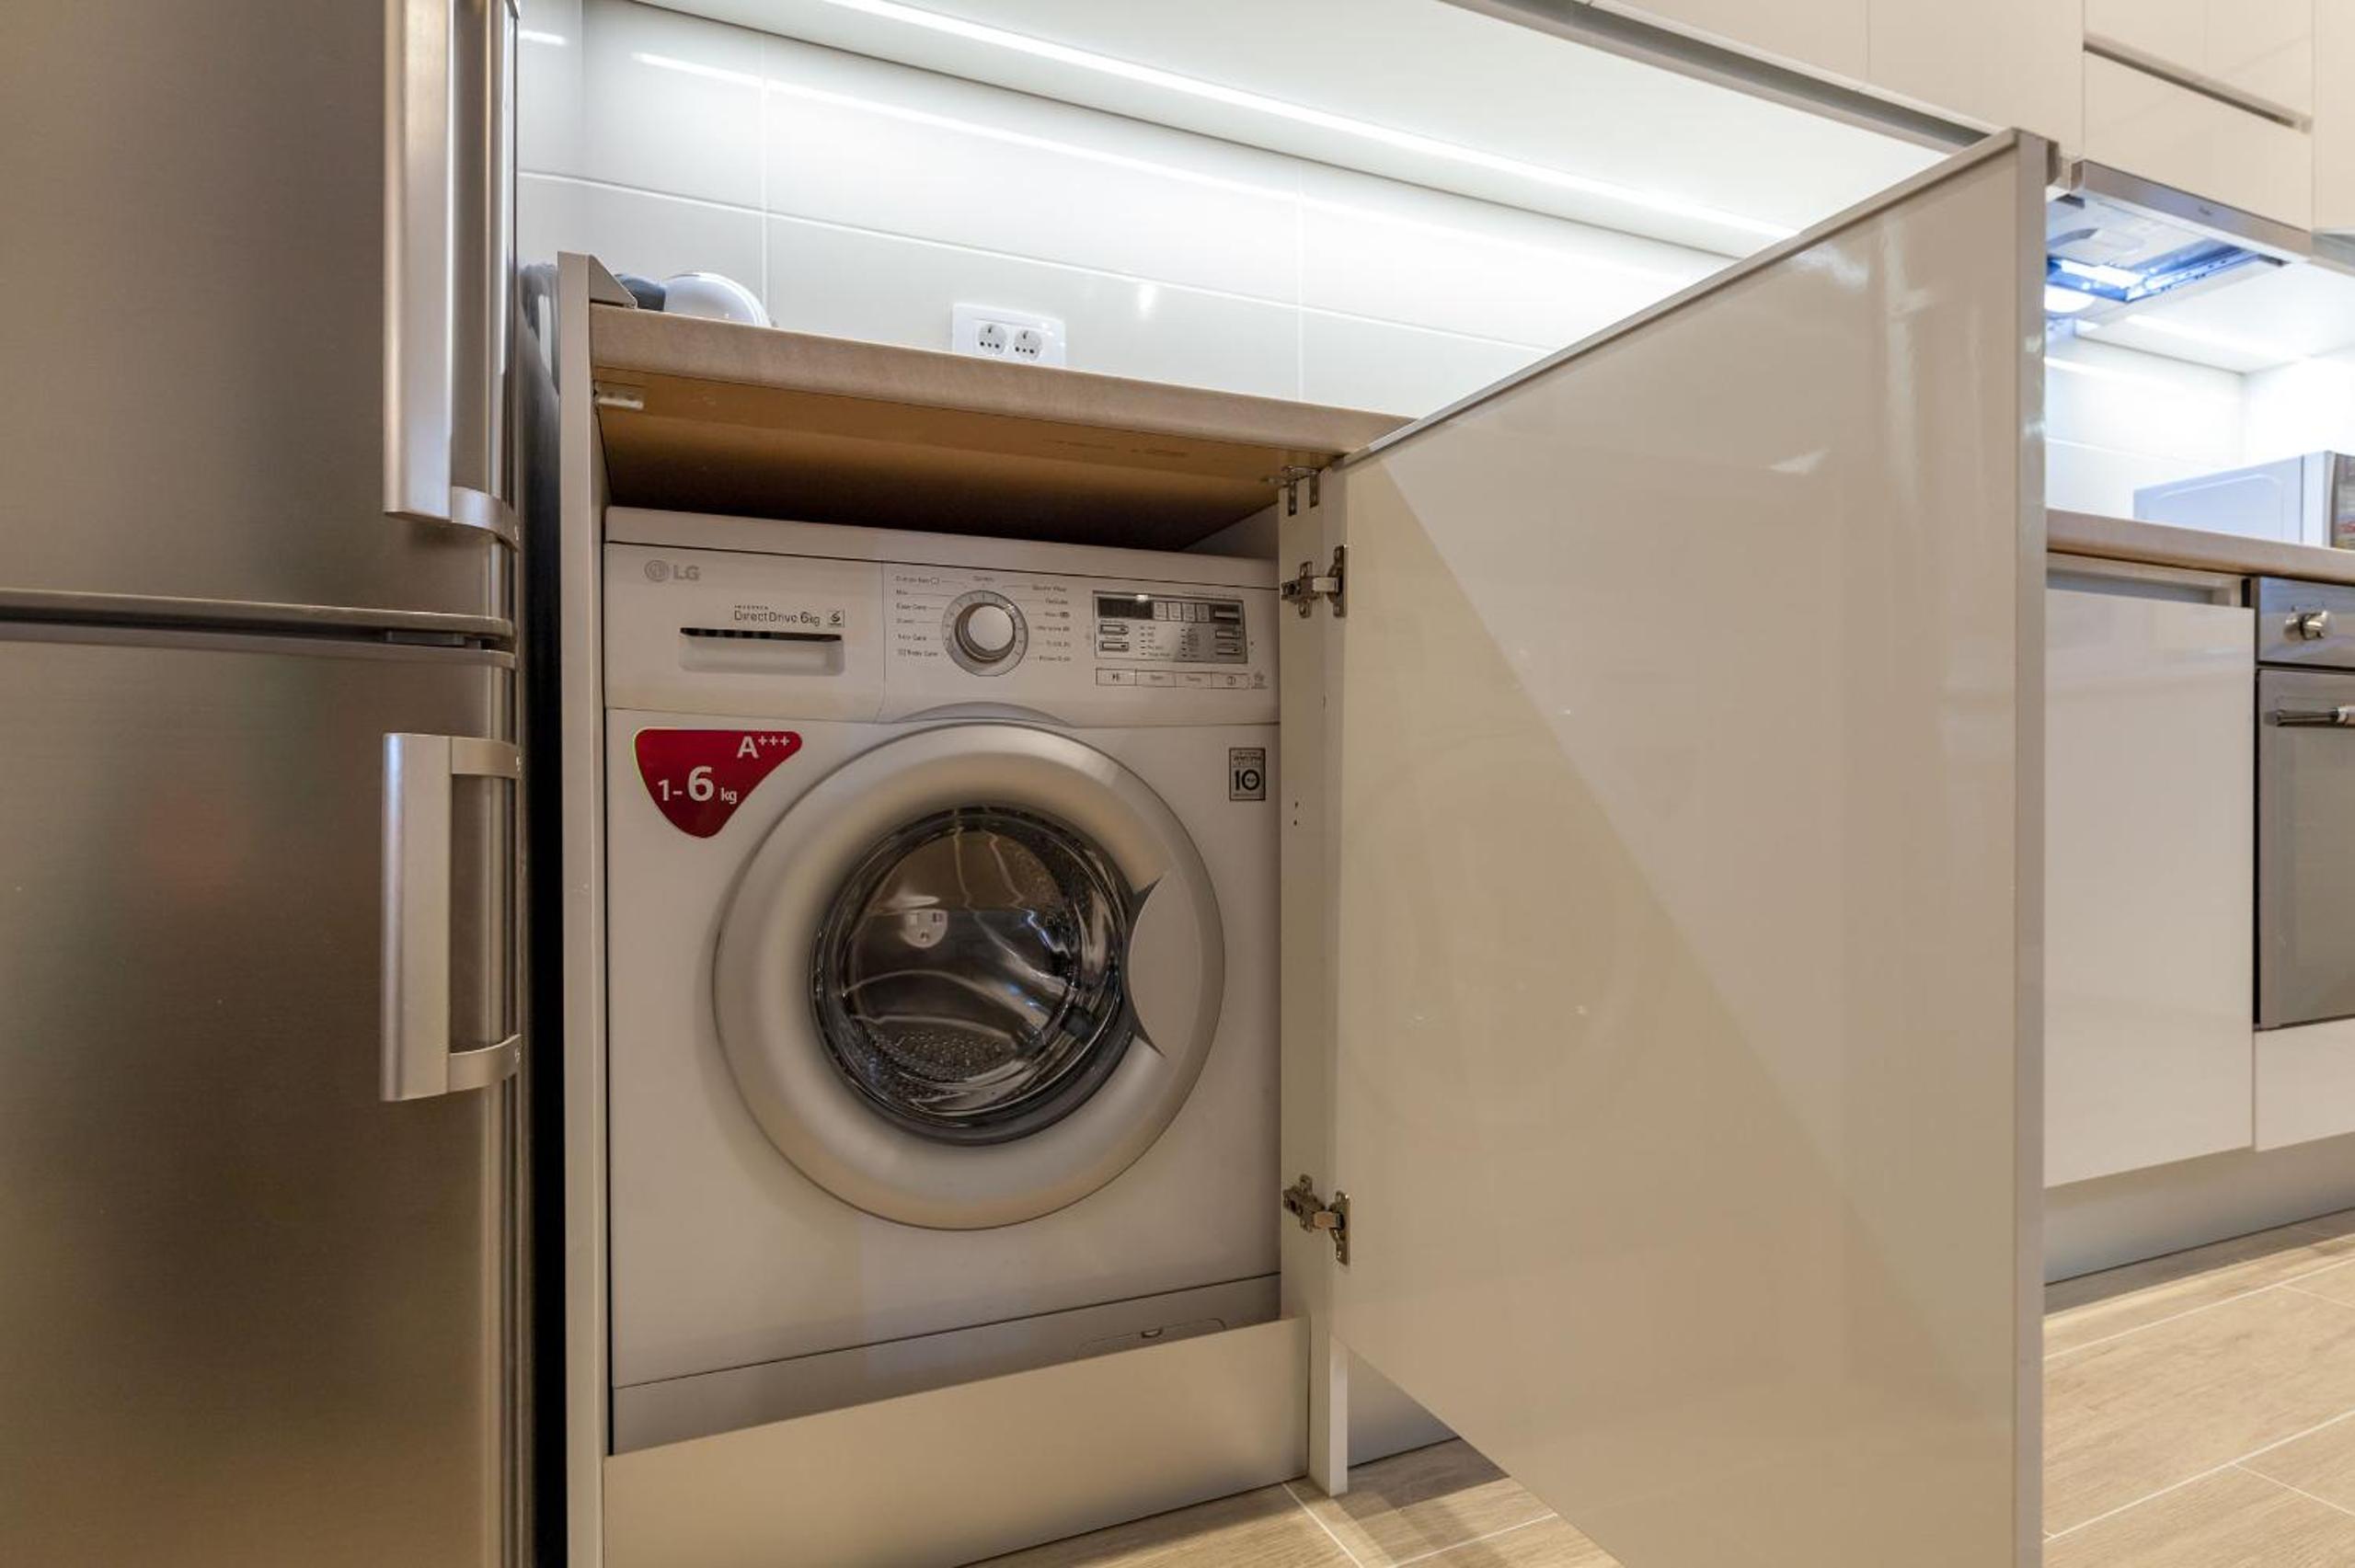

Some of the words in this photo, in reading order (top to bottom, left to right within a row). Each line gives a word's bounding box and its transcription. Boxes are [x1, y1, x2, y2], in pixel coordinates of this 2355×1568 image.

[673, 565, 700, 580] LG
[737, 735, 790, 759] A+++
[720, 787, 738, 805] kg
